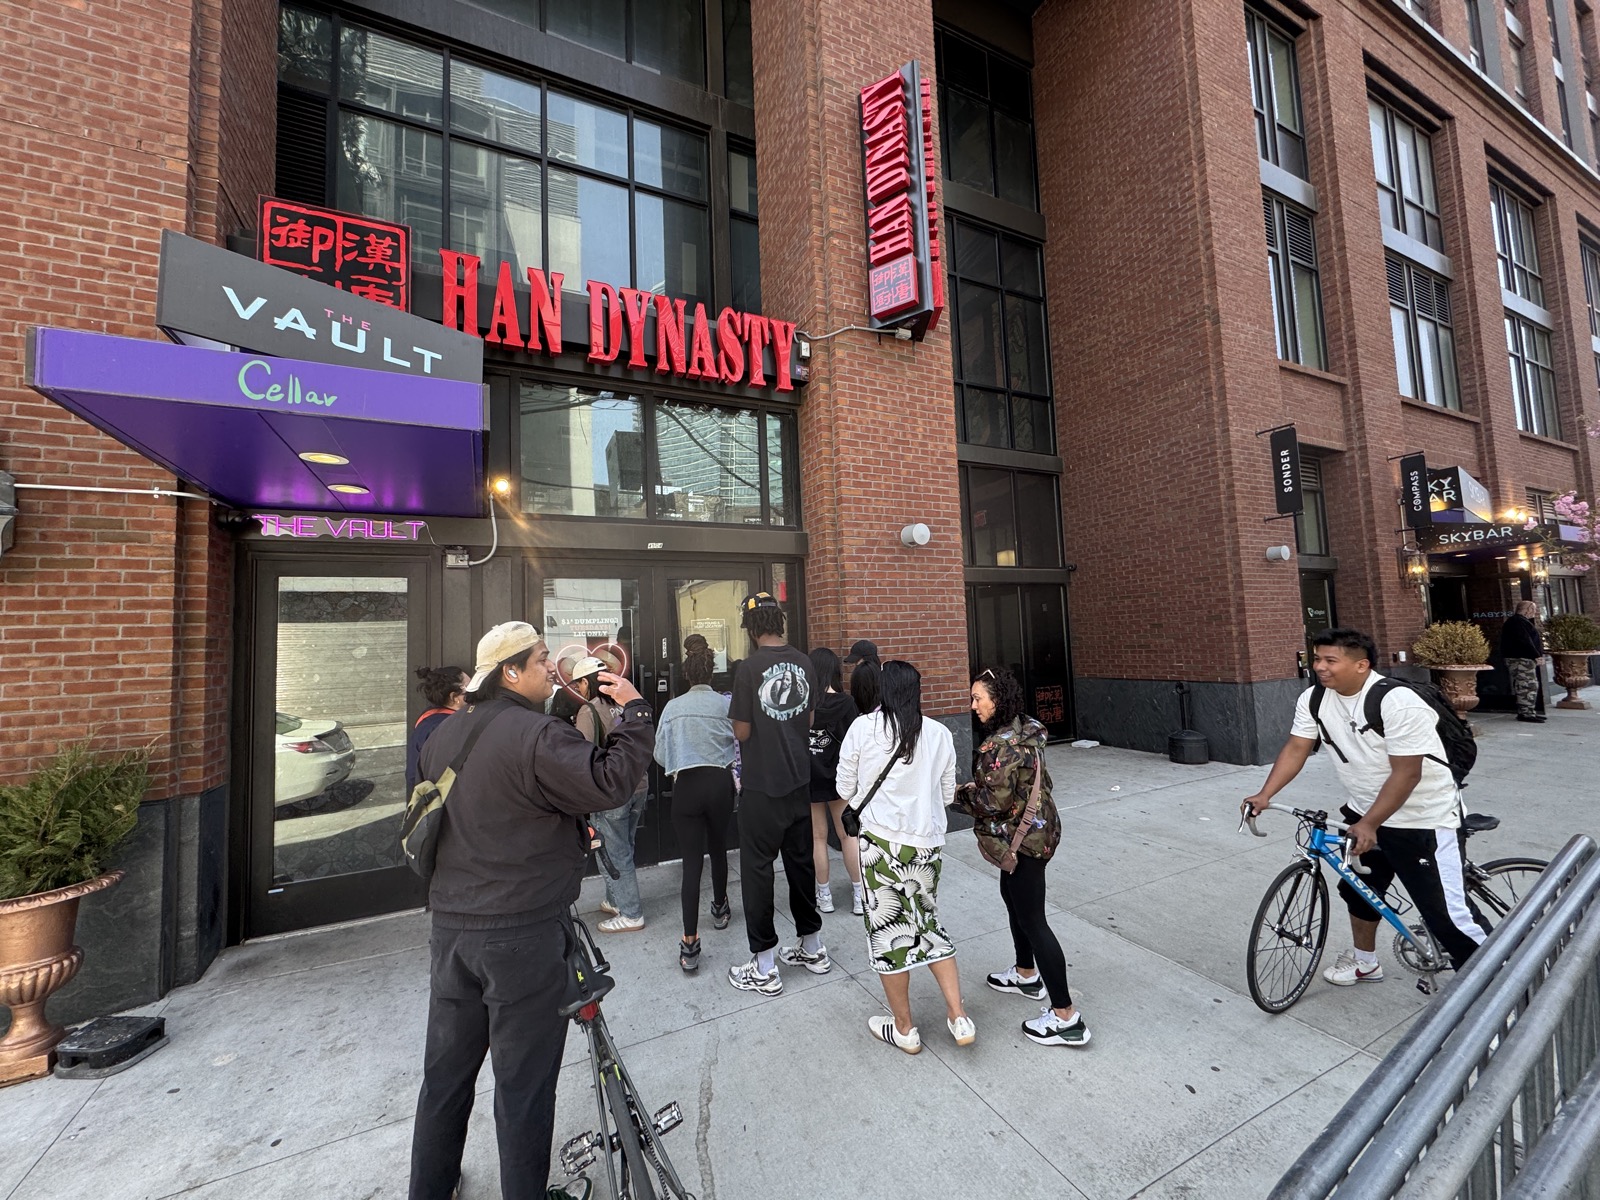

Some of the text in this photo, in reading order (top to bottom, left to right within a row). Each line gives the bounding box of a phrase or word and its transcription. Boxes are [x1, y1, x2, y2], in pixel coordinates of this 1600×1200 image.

[861, 69, 914, 266] HAN DYNASTY
[221, 285, 442, 374] VAULT
[324, 308, 372, 331] THE
[439, 248, 797, 394] HAN DYNASTY
[237, 360, 338, 407] Cellar
[1280, 448, 1293, 493] SONDER
[1410, 470, 1422, 511] COMPASS
[1427, 476, 1452, 493] KY
[1429, 489, 1456, 503] AR
[251, 514, 425, 541] THE VAULT
[1438, 526, 1513, 544] SKYBAR
